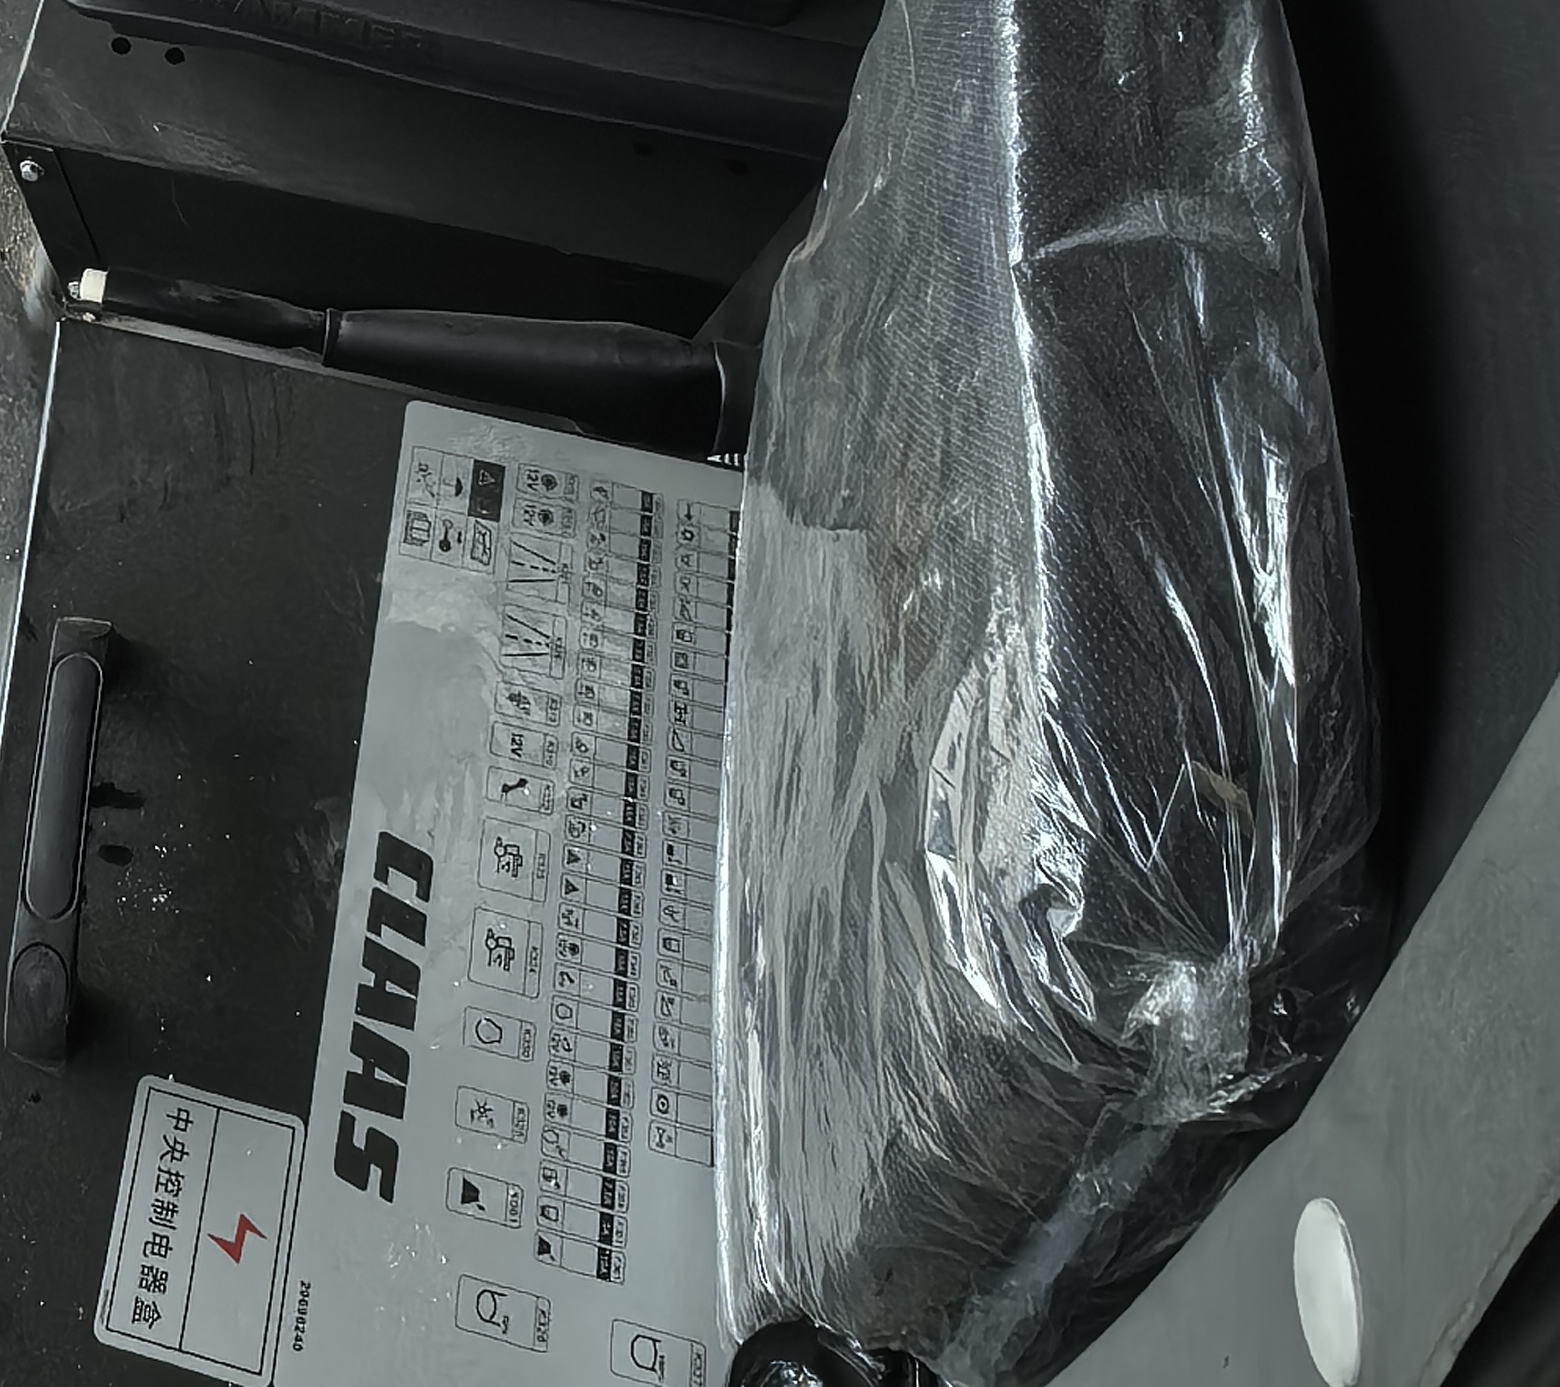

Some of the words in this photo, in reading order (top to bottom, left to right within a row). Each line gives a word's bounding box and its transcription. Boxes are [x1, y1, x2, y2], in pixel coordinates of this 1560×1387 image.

[524, 468, 540, 490] 12V
[508, 732, 524, 757] 12V
[334, 830, 435, 1204] CLAAS
[131, 1107, 194, 1330] 中央控制电器盒
